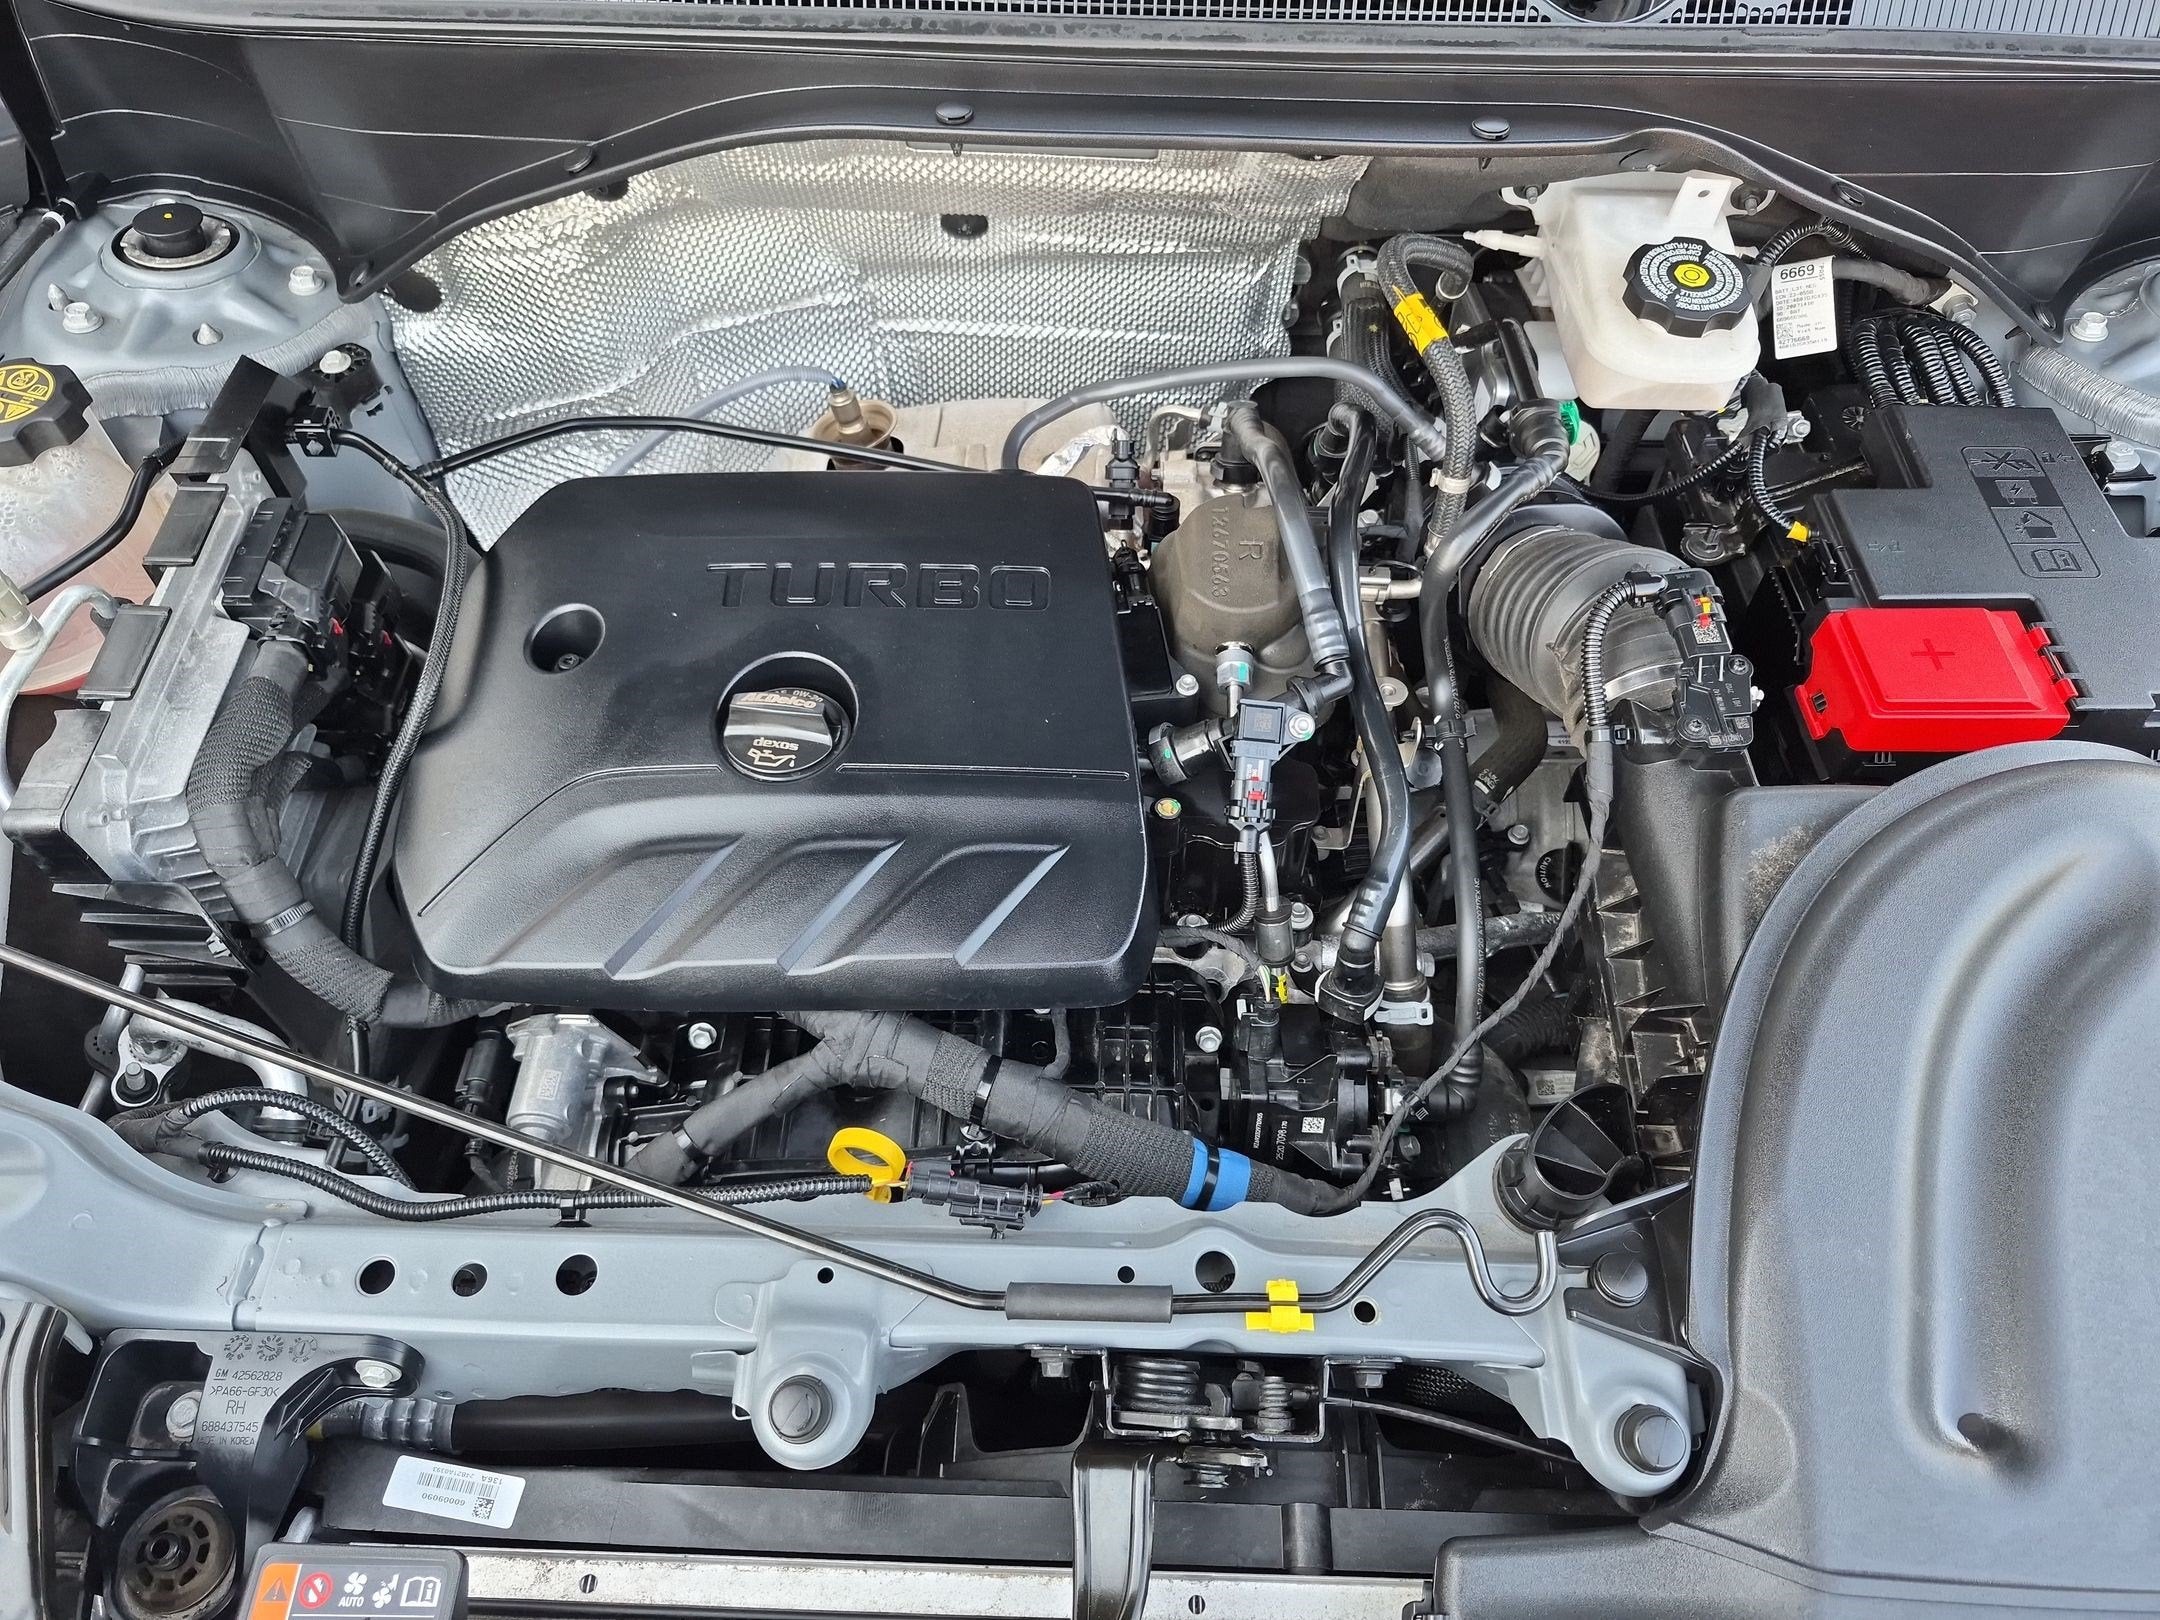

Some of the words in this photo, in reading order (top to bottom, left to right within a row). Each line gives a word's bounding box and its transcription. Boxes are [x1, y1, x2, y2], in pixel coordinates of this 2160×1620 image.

[1780, 264, 1815, 280] 6669
[1238, 541, 1264, 560] R
[706, 562, 1051, 612] TURBO
[741, 693, 816, 709] ACDelco
[752, 737, 799, 751] dexos
[1541, 857, 1552, 889] CAUTION
[215, 1368, 229, 1378] GM
[232, 1370, 283, 1381] 42562828
[210, 1385, 280, 1397] >PA66-GF30<
[226, 1399, 247, 1415] RH
[201, 1421, 259, 1433] 688437545
[220, 1437, 226, 1445] IN
[230, 1437, 255, 1445] KOREA
[481, 1475, 503, 1486] 136A
[422, 1492, 466, 1507] 60009090
[338, 1596, 364, 1607] AUTO
